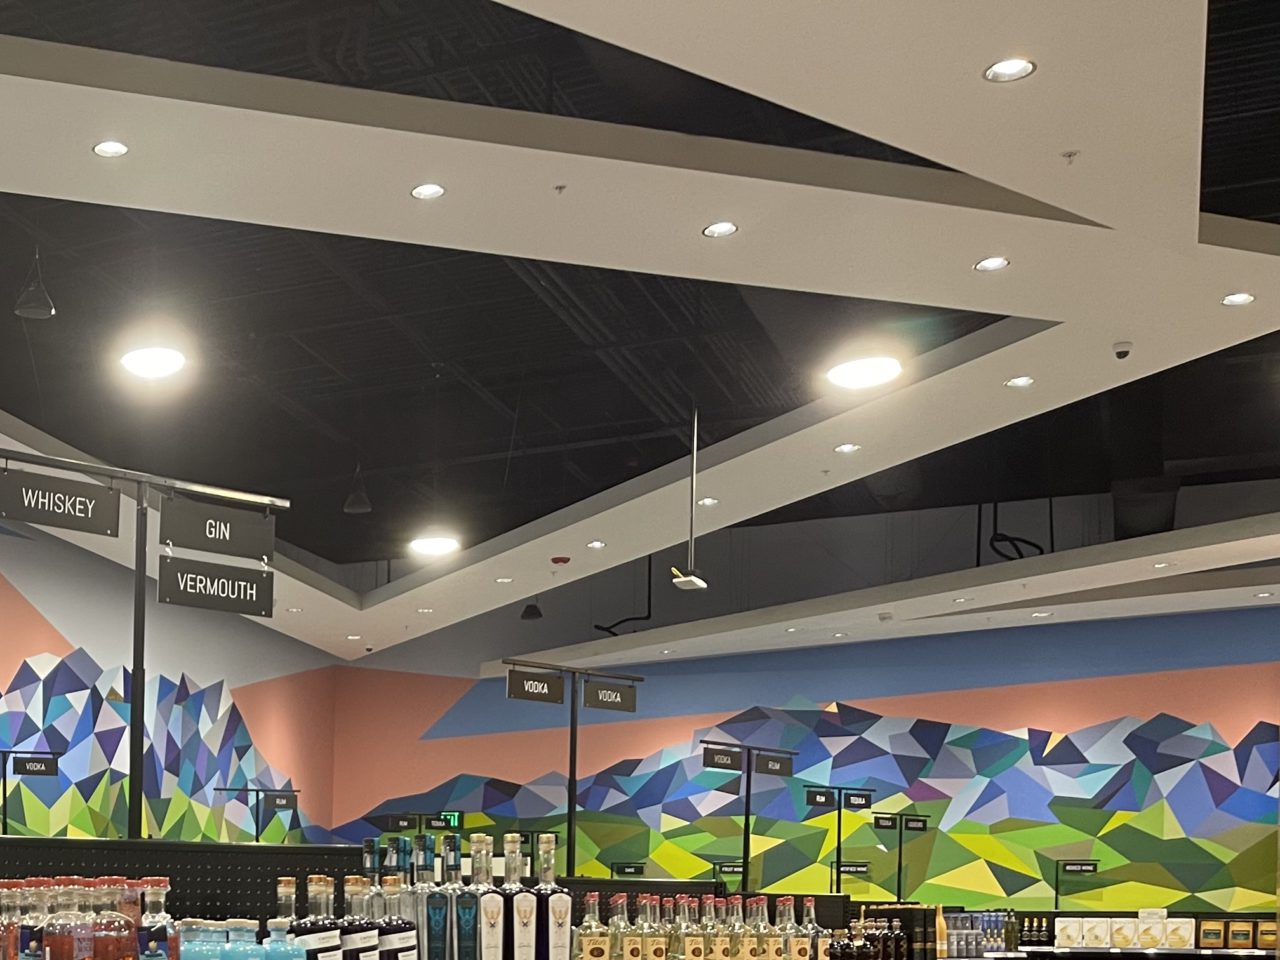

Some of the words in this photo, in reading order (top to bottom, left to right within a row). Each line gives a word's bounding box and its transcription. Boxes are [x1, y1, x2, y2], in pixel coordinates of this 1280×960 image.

[22, 487, 96, 518] WHISKEY
[205, 519, 231, 541] GIN
[176, 572, 257, 602] VERMOUTH
[523, 680, 550, 695] VODKA
[597, 690, 622, 703] VODKA
[25, 762, 46, 771] VODKA
